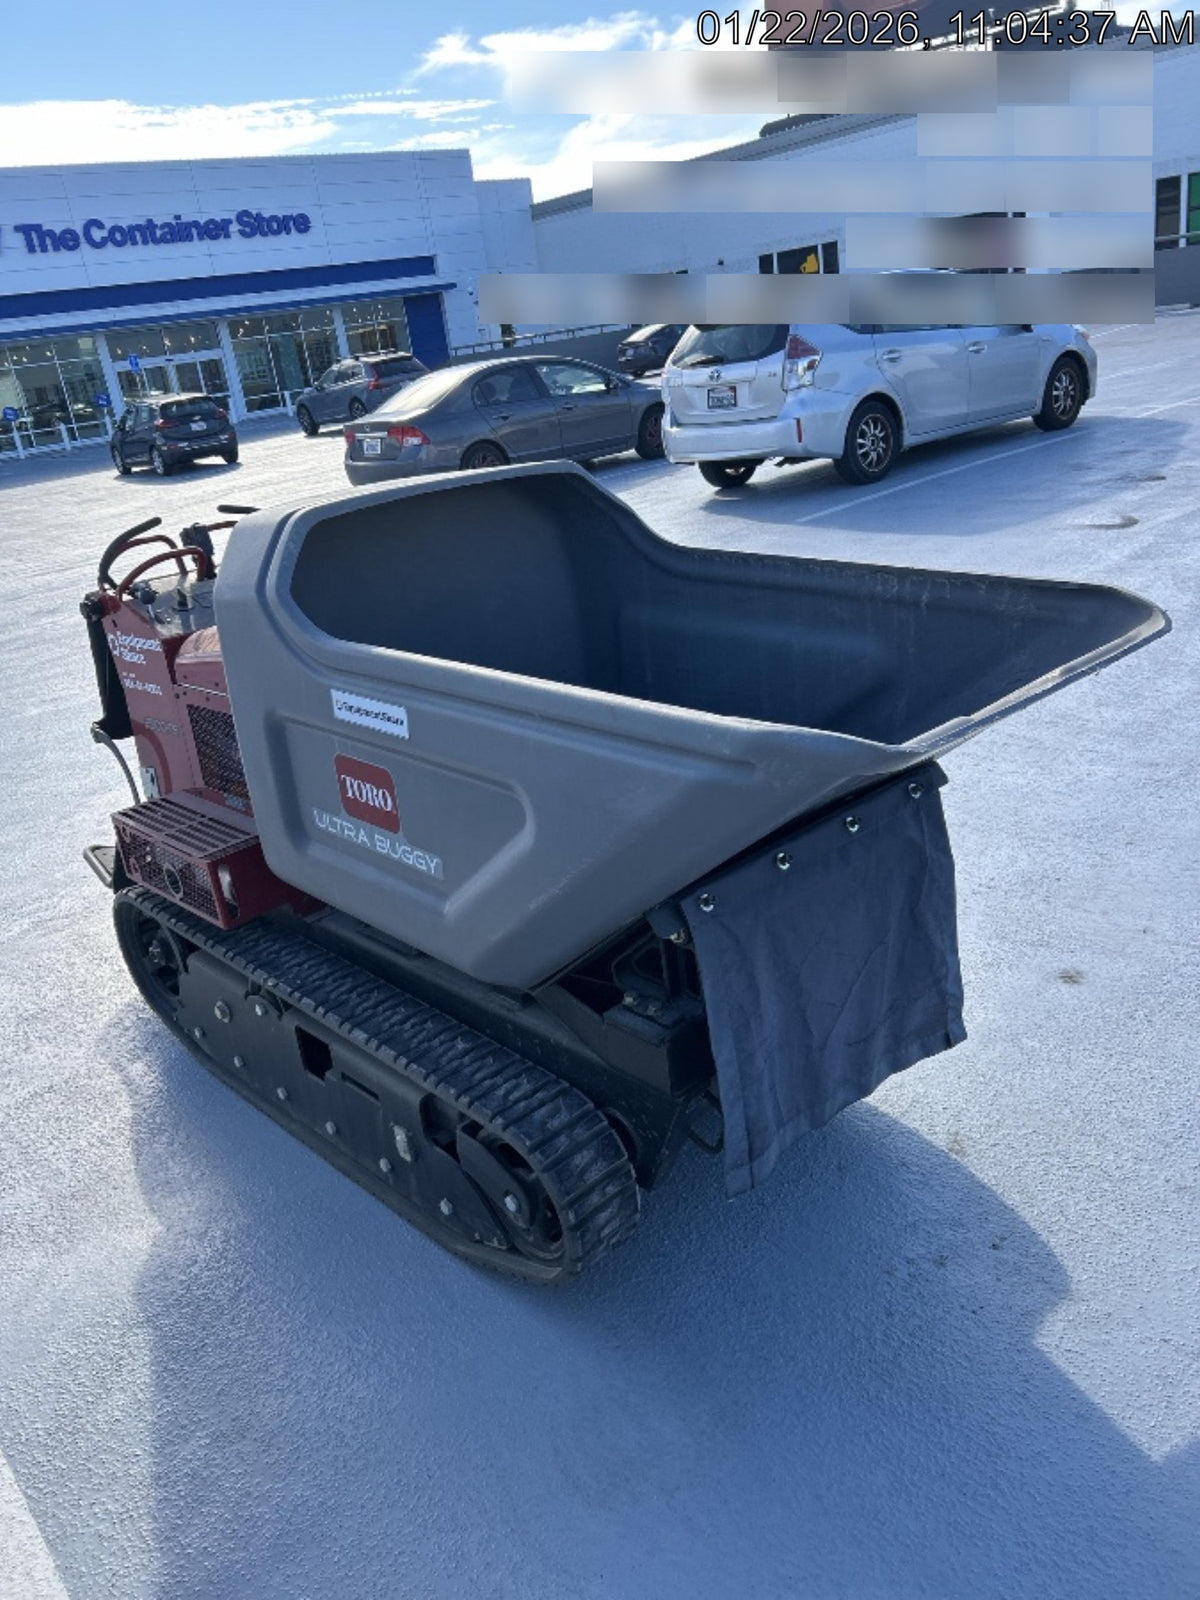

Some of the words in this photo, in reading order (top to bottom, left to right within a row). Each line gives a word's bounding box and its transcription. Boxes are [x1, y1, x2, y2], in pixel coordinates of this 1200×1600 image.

[14, 223, 81, 253] The
[83, 215, 233, 249] Container
[236, 209, 311, 238] Store
[341, 774, 393, 812] TORO
[313, 808, 371, 848] ULTRA
[374, 833, 442, 876] BUGGY
